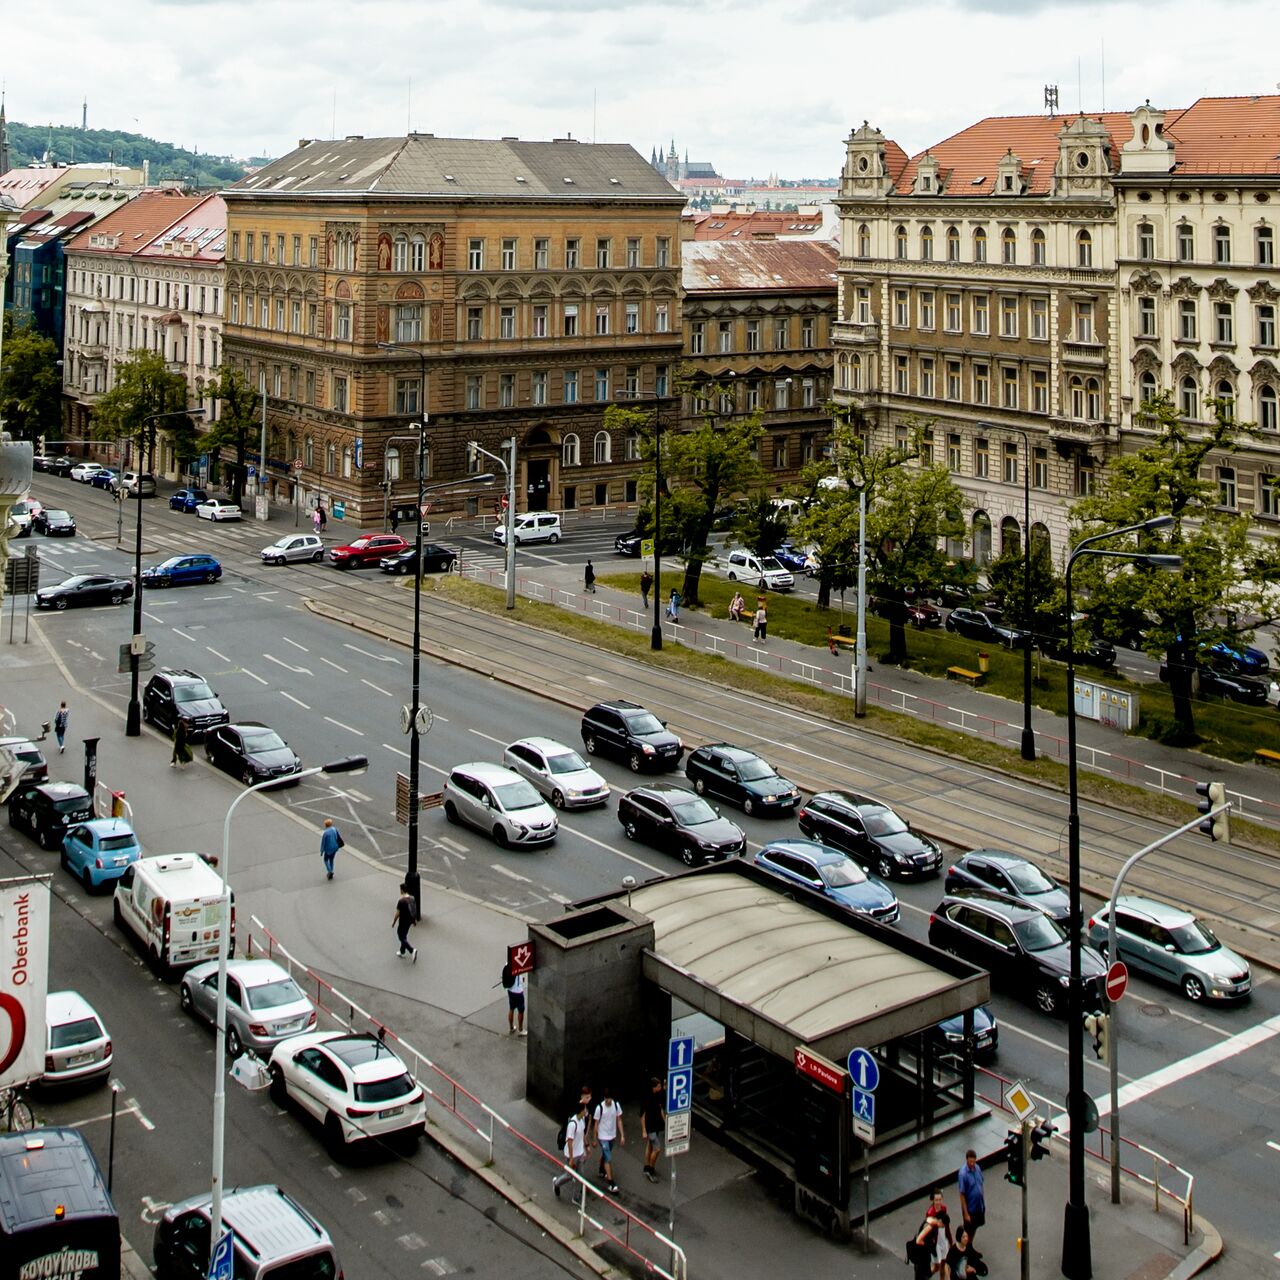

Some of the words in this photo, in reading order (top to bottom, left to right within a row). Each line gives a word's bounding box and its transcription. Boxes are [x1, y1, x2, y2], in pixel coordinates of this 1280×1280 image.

[12, 893, 29, 986] Oberbank
[673, 1074, 687, 1100] P
[20, 1245, 99, 1280] KOVOVÝROBA
[213, 1241, 228, 1273] P
